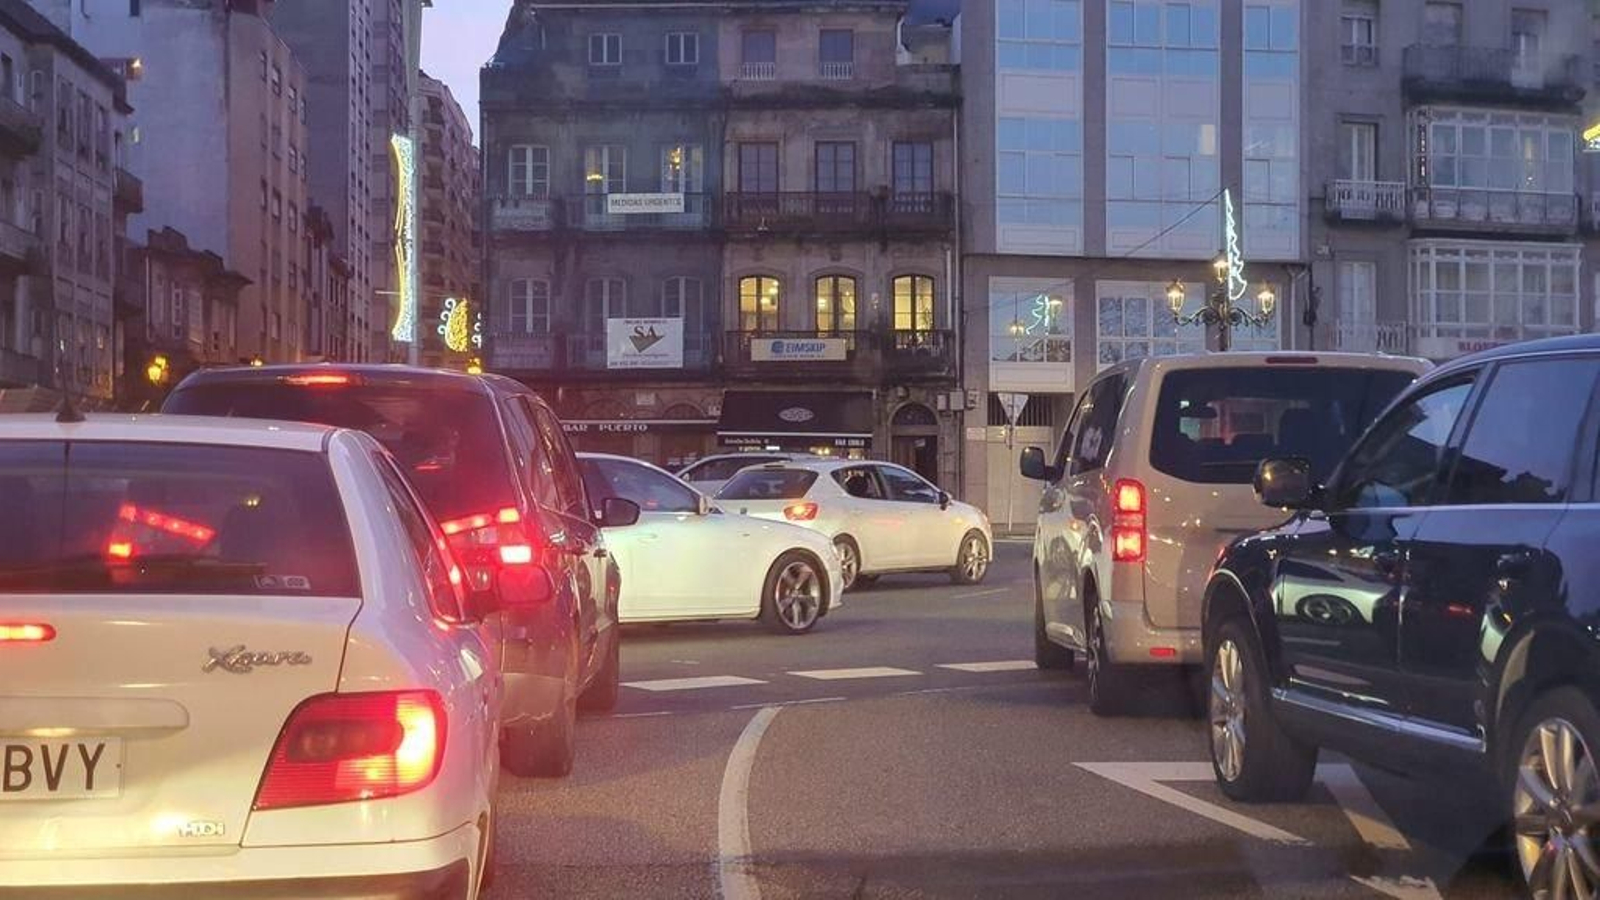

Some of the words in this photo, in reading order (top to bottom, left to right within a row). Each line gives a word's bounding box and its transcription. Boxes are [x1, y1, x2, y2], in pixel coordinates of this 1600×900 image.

[785, 342, 826, 354] EIMSKIP
[562, 424, 588, 432] BAR
[599, 424, 648, 432] PUERTO
[201, 644, 313, 675] Xsara
[2, 742, 106, 793] BVY
